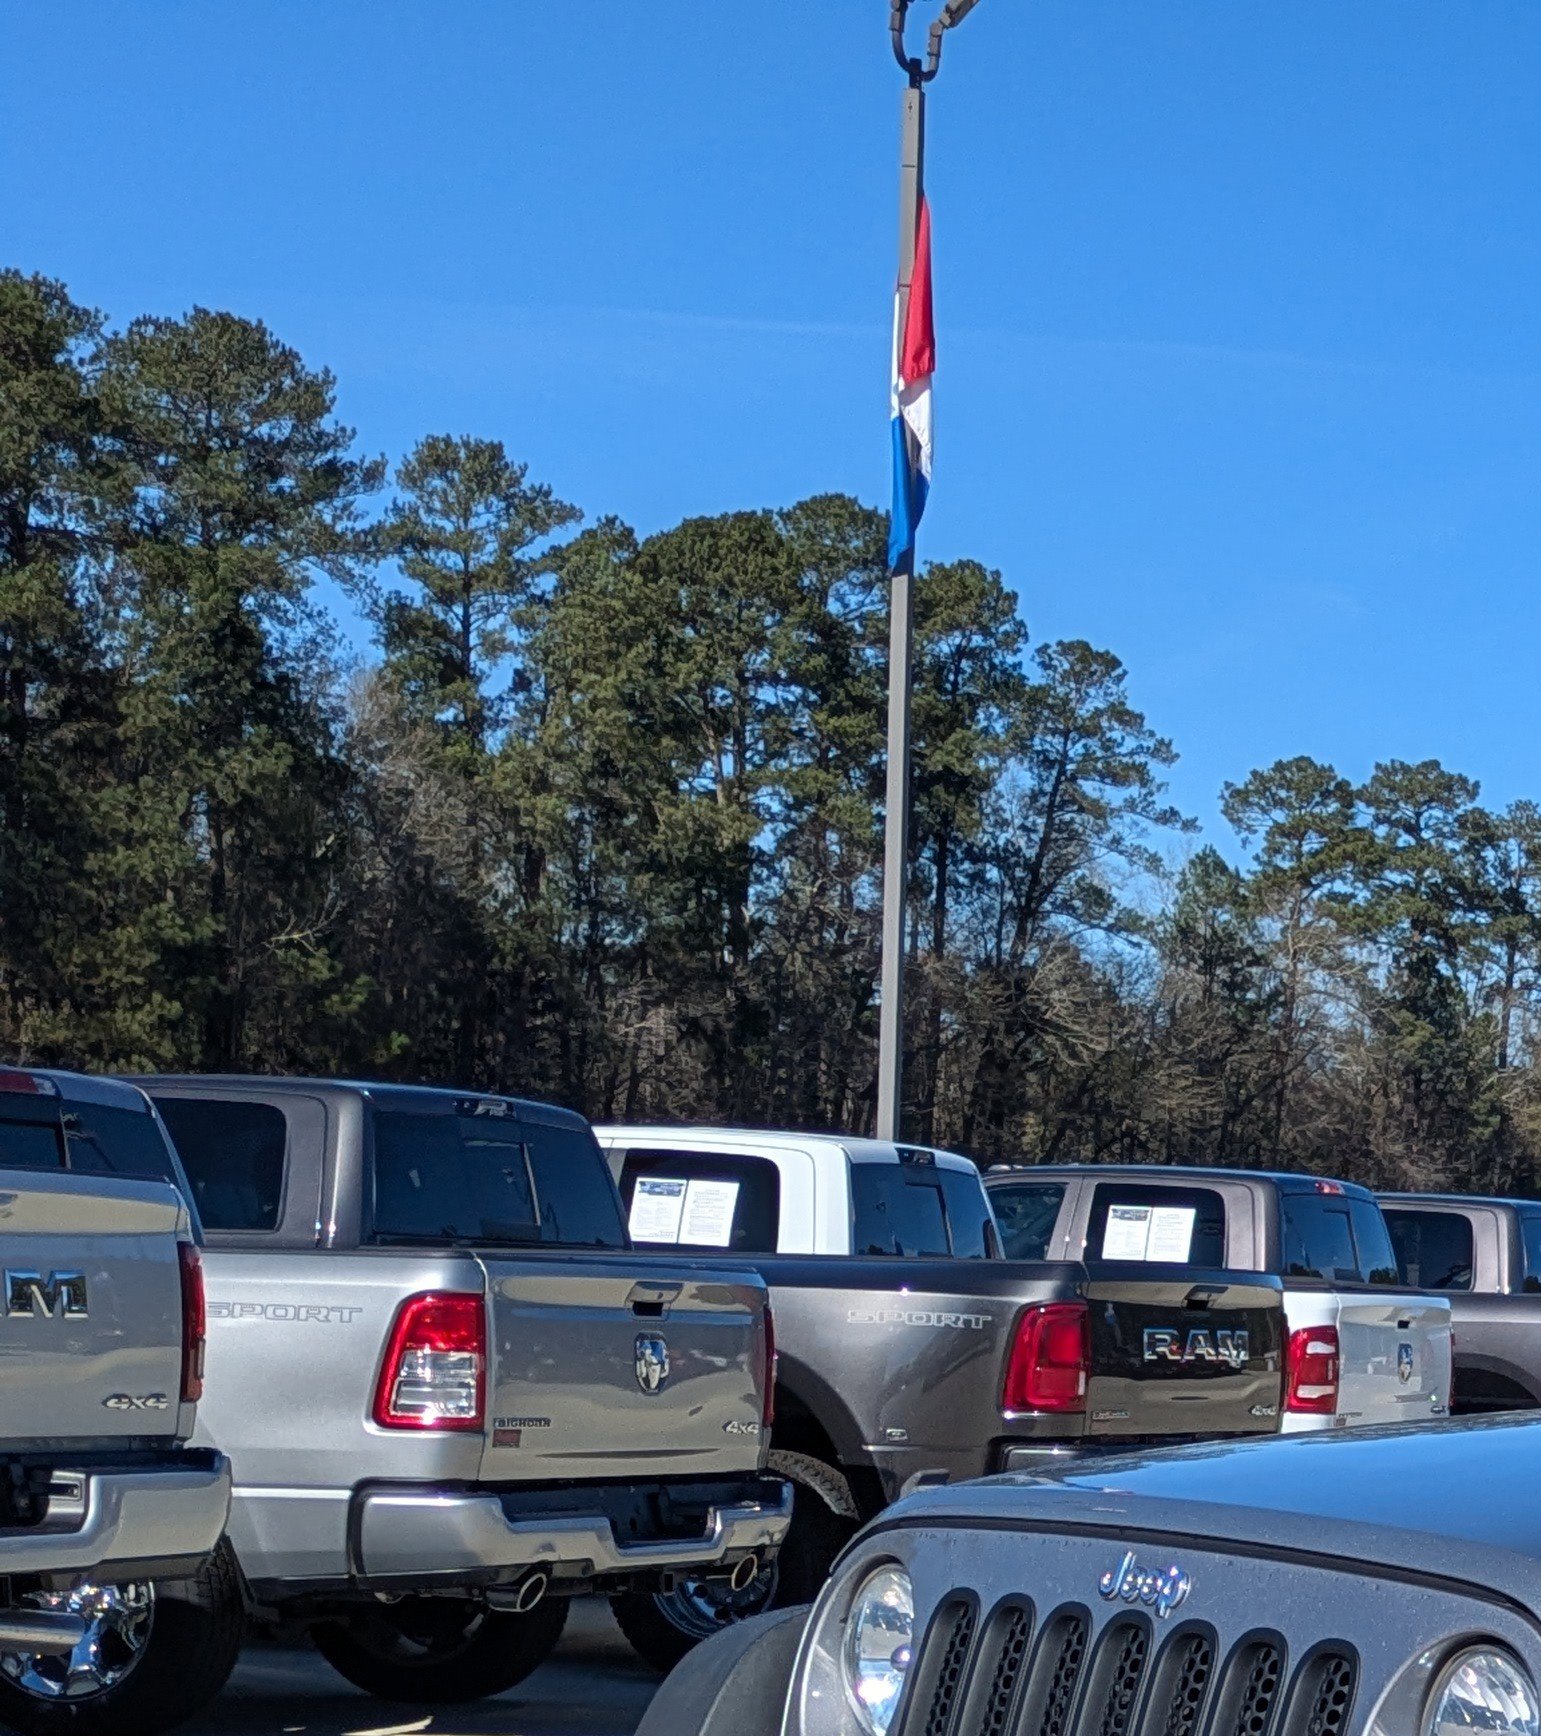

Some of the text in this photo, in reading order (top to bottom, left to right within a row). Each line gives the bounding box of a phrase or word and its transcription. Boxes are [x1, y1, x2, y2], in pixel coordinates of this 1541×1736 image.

[208, 1301, 363, 1323] SPORT
[846, 1309, 992, 1329] SPORT
[1143, 1328, 1250, 1363] RAM
[1099, 1551, 1191, 1619] Jeep
